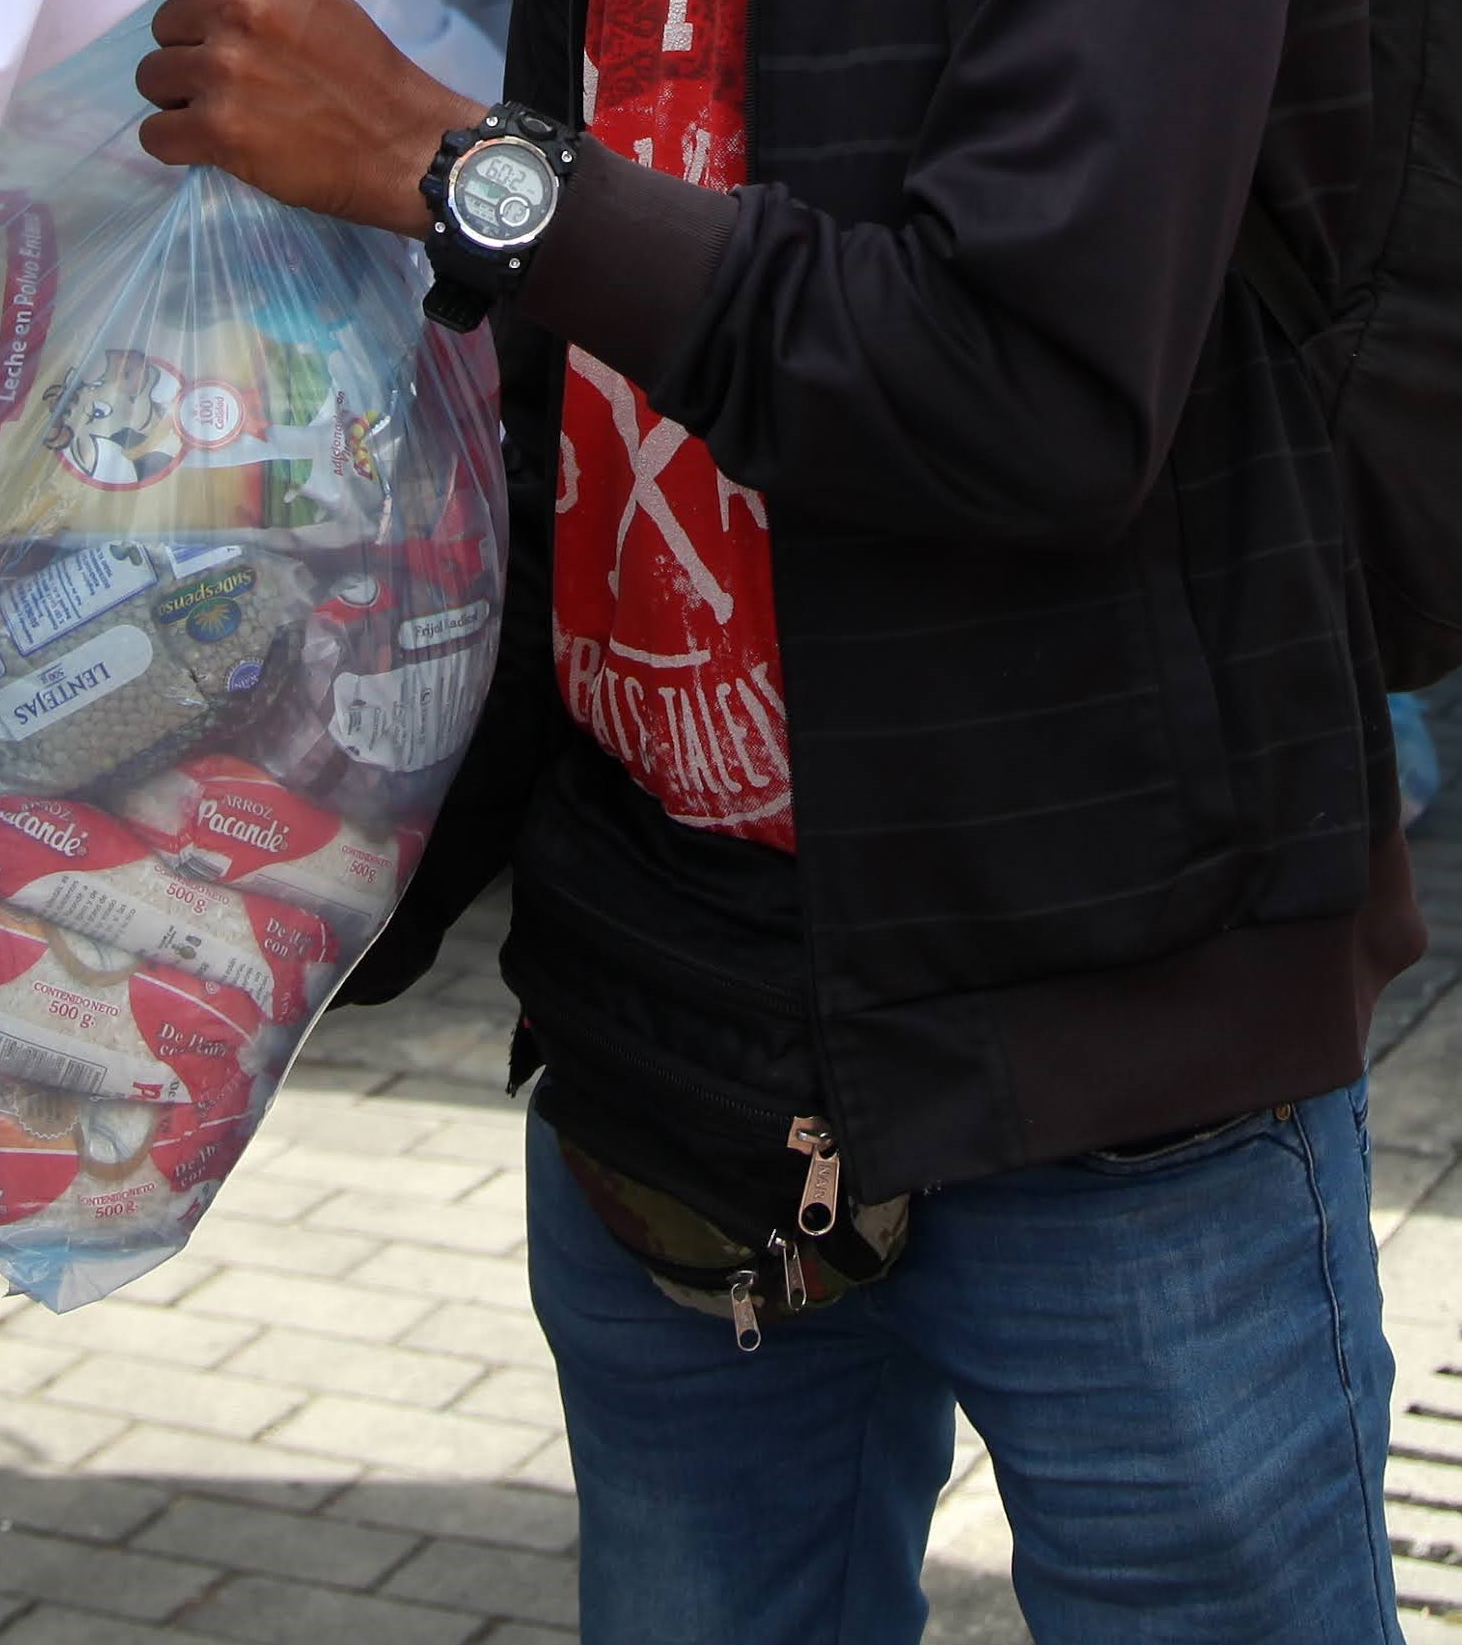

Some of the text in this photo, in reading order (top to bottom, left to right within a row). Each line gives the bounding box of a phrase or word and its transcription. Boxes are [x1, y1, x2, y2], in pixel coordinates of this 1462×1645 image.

[14, 255, 40, 307] Polvo
[15, 308, 33, 336] en
[13, 660, 112, 726] LENTEJAS
[222, 794, 274, 820] ARROZ
[197, 798, 290, 853] Pacandé
[349, 859, 369, 877] 500
[165, 881, 194, 905] 500
[33, 981, 121, 1018] CONTENIDO NETO
[48, 1001, 79, 1021] 500
[94, 1203, 123, 1219] 500
